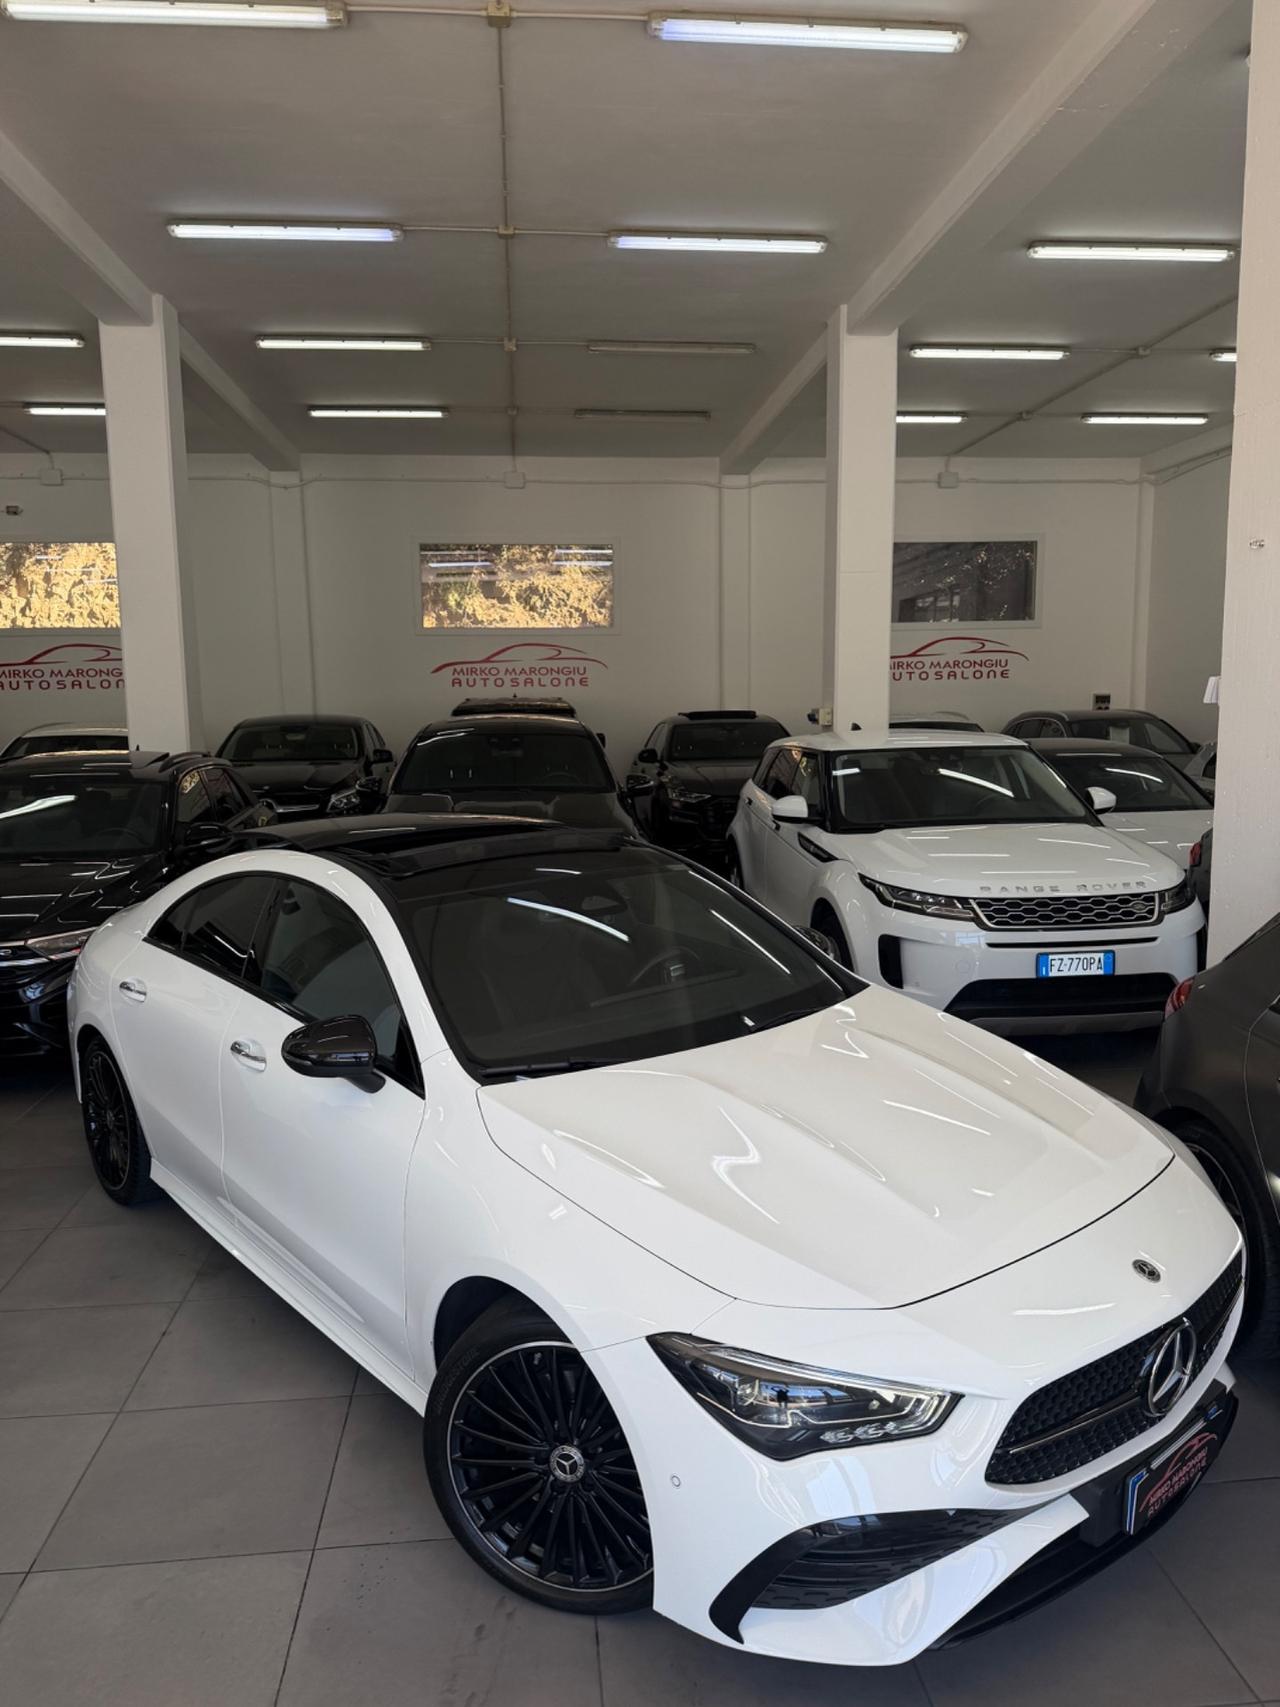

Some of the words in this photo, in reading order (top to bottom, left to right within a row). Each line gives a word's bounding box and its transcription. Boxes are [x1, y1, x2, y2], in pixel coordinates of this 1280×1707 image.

[889, 660, 925, 671] IRKO
[929, 659, 1009, 670] MARONGIU
[49, 667, 123, 679] MARONG
[452, 667, 500, 677] MIRKO
[504, 666, 587, 677] MARONGIU
[892, 669, 1011, 681] UTOSALONE
[0, 678, 125, 691] UTOSALON
[451, 677, 590, 688] AUTOSALONE
[979, 885, 1061, 893] RANGE
[1076, 881, 1147, 892] ROVER
